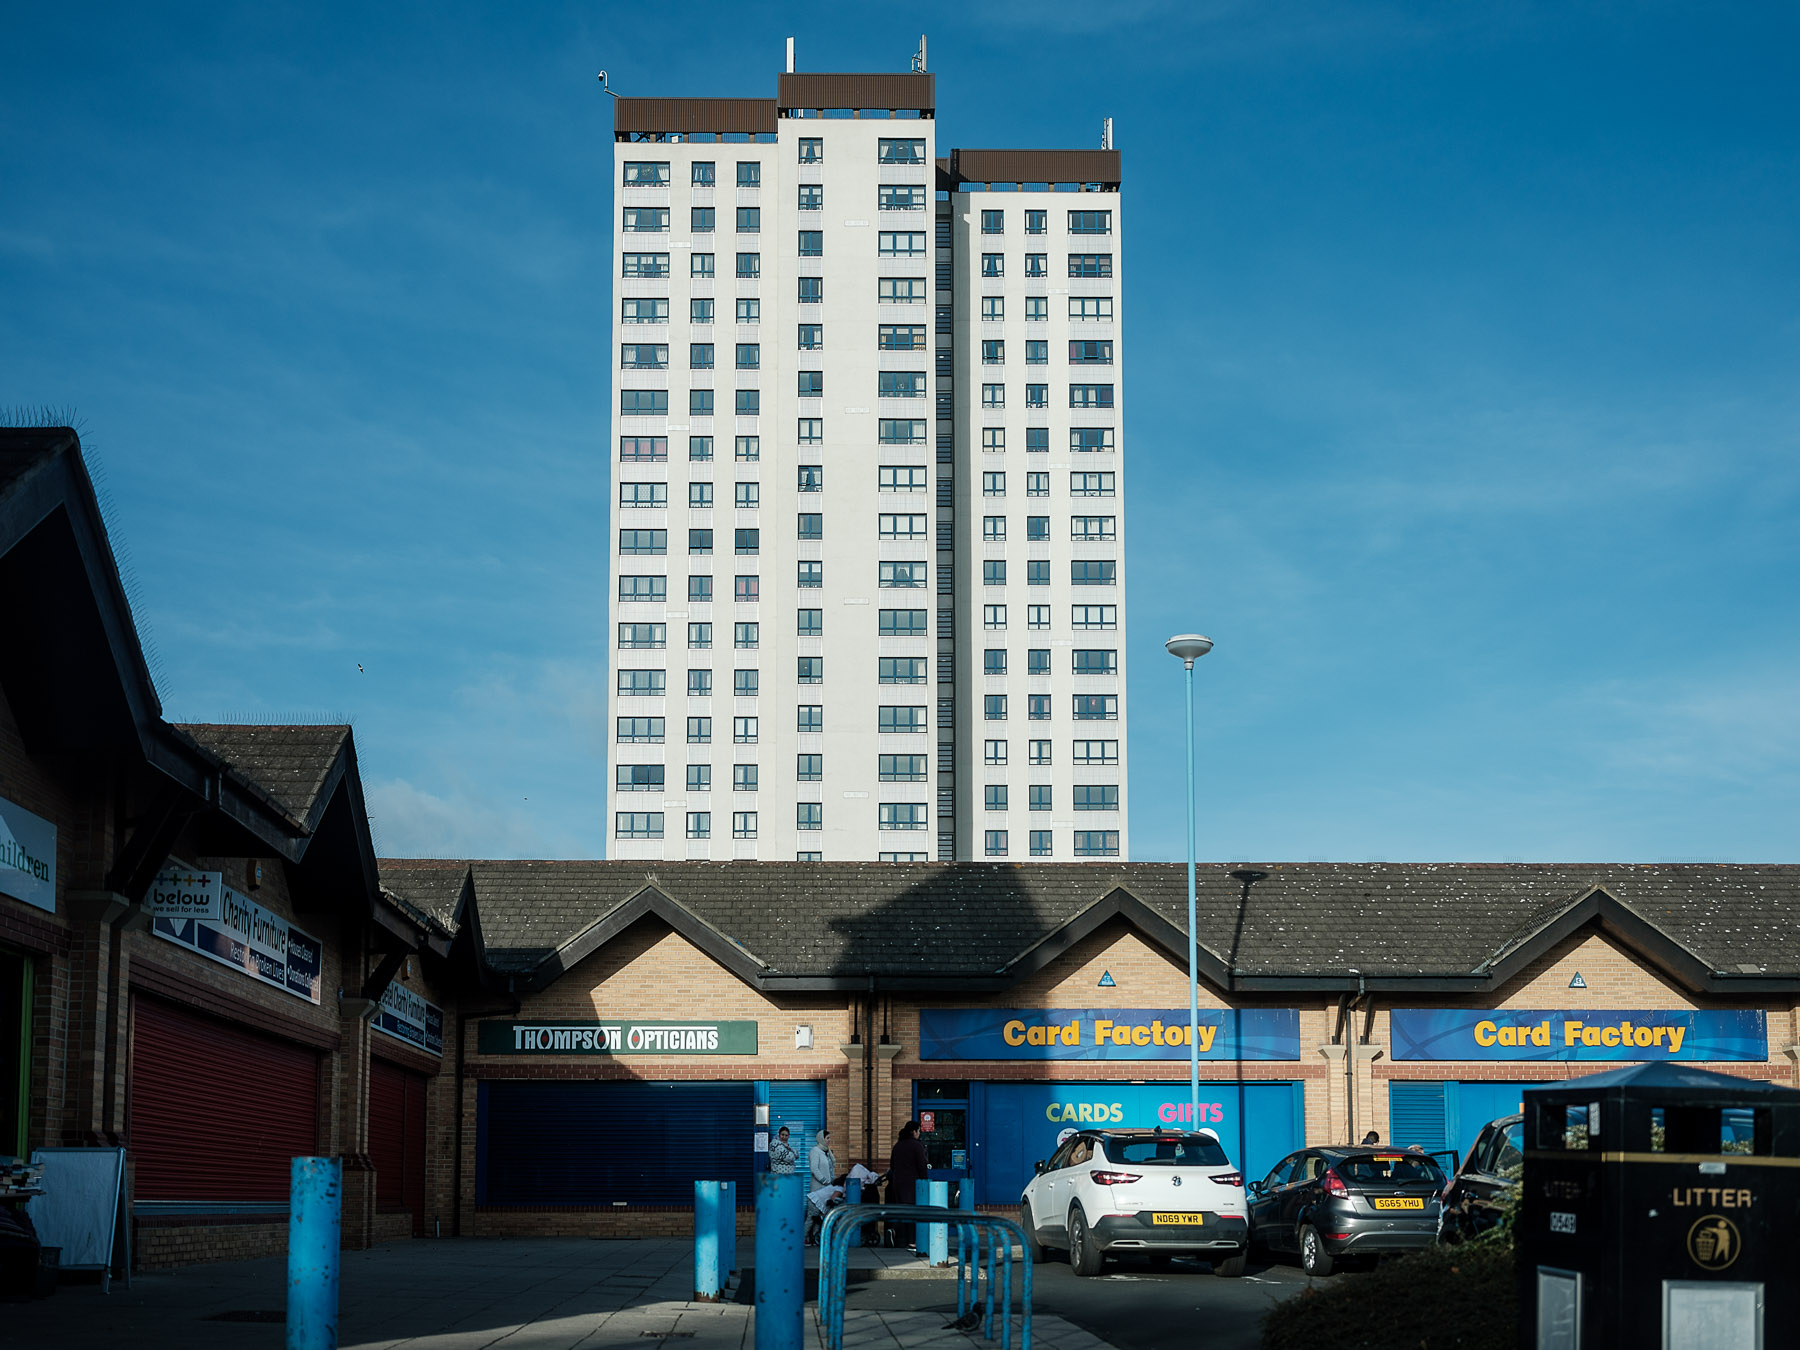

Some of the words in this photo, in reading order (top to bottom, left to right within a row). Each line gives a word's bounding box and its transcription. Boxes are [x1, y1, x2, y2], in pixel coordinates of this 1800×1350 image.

[153, 888, 210, 906] below
[165, 905, 180, 913] sell
[181, 905, 192, 913] for
[193, 905, 209, 914] less
[223, 891, 252, 945] Charity
[253, 908, 286, 954] Furniture
[272, 961, 284, 982] Lives
[1003, 1020, 1080, 1046] Card
[1095, 1020, 1217, 1052] Factory
[1474, 1020, 1551, 1047] Card
[1564, 1020, 1686, 1053] Factory
[1046, 1103, 1123, 1122] CARDS
[1158, 1103, 1223, 1122] GIFTS
[1379, 1199, 1402, 1208] SG65
[1402, 1199, 1420, 1208] YHU
[1673, 1188, 1752, 1208] LITTER
[1181, 1214, 1199, 1224] YWR
